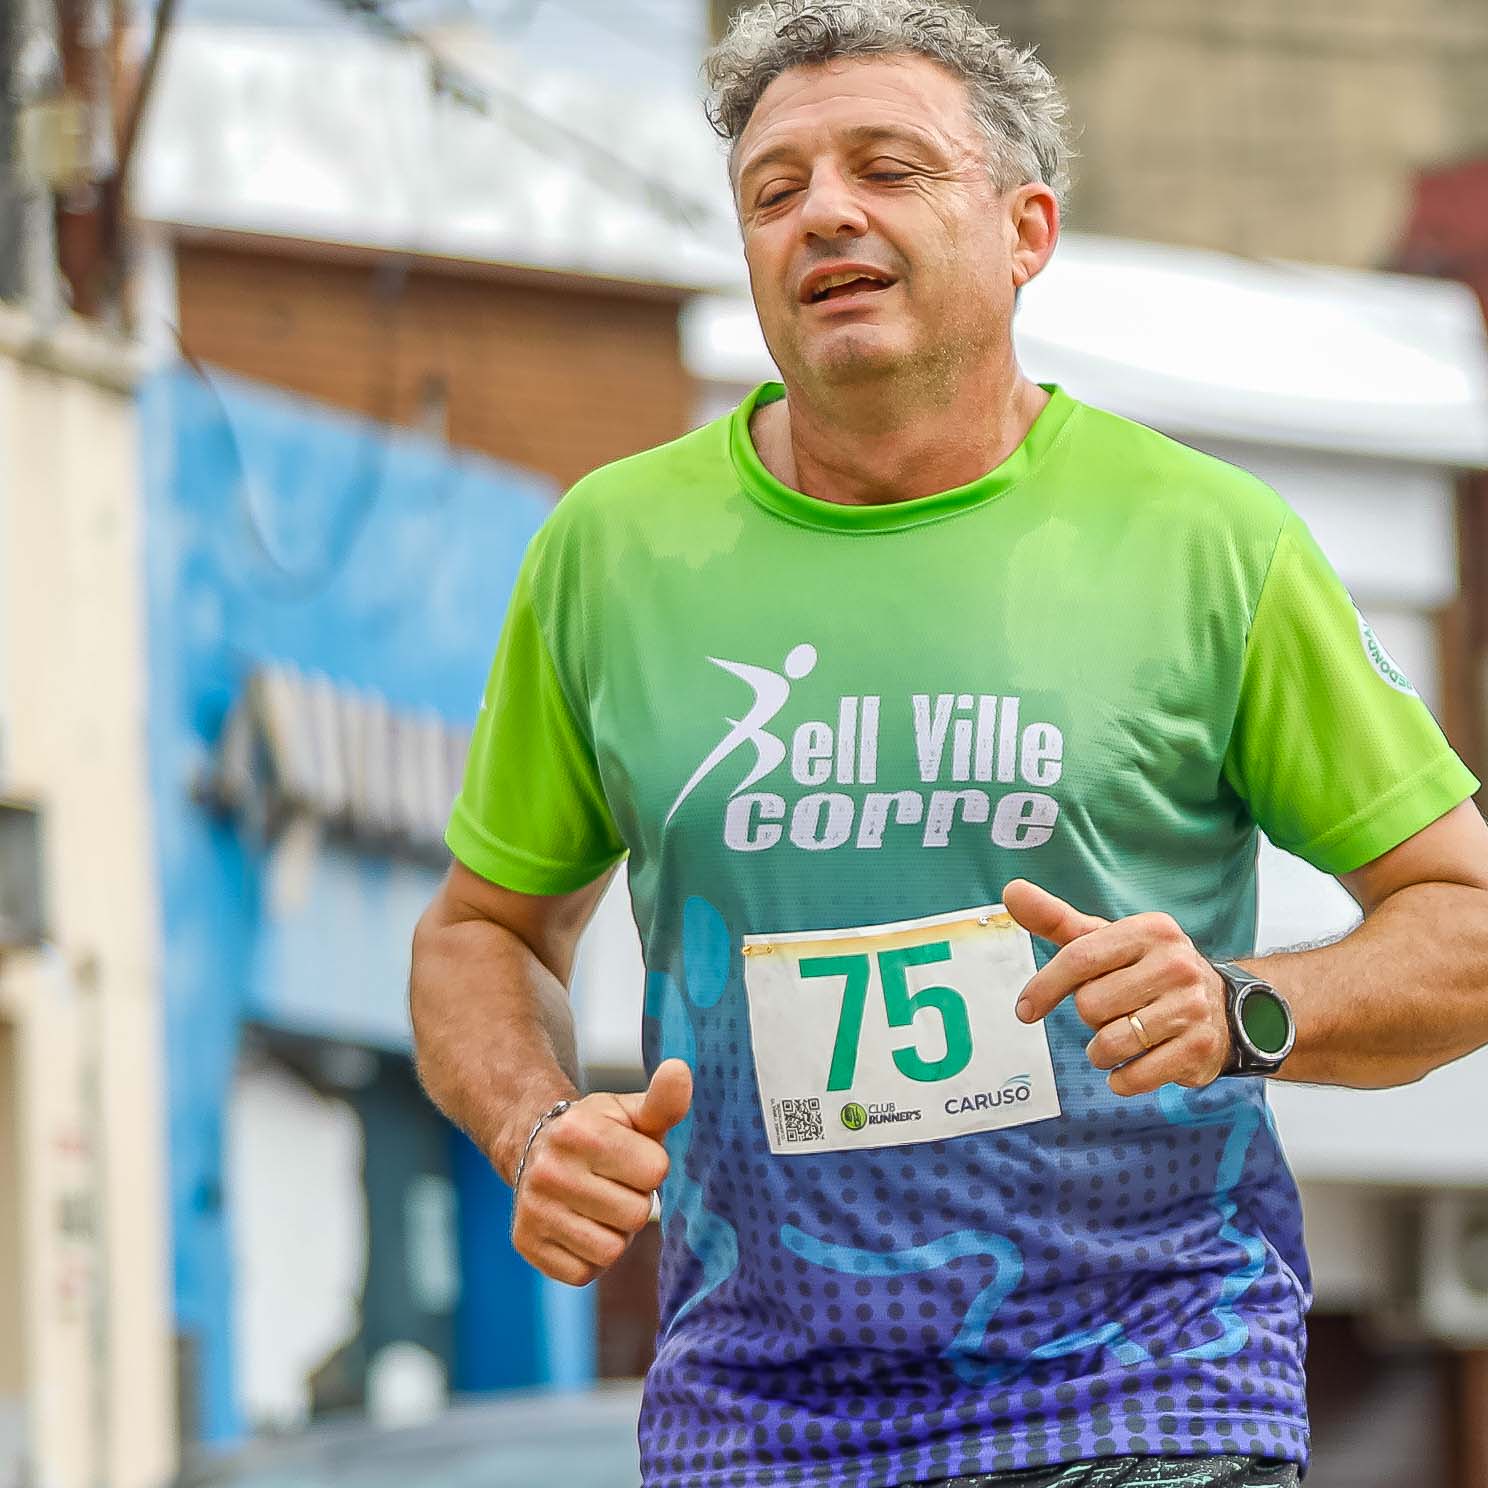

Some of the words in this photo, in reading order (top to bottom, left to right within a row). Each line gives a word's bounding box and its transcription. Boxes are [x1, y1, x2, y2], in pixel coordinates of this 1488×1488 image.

[912, 693, 1064, 787] Ville
[723, 788, 1061, 851] corre
[798, 940, 974, 1092] 75
[868, 1102, 896, 1114] CLUB
[944, 1085, 1031, 1115] CARUSO
